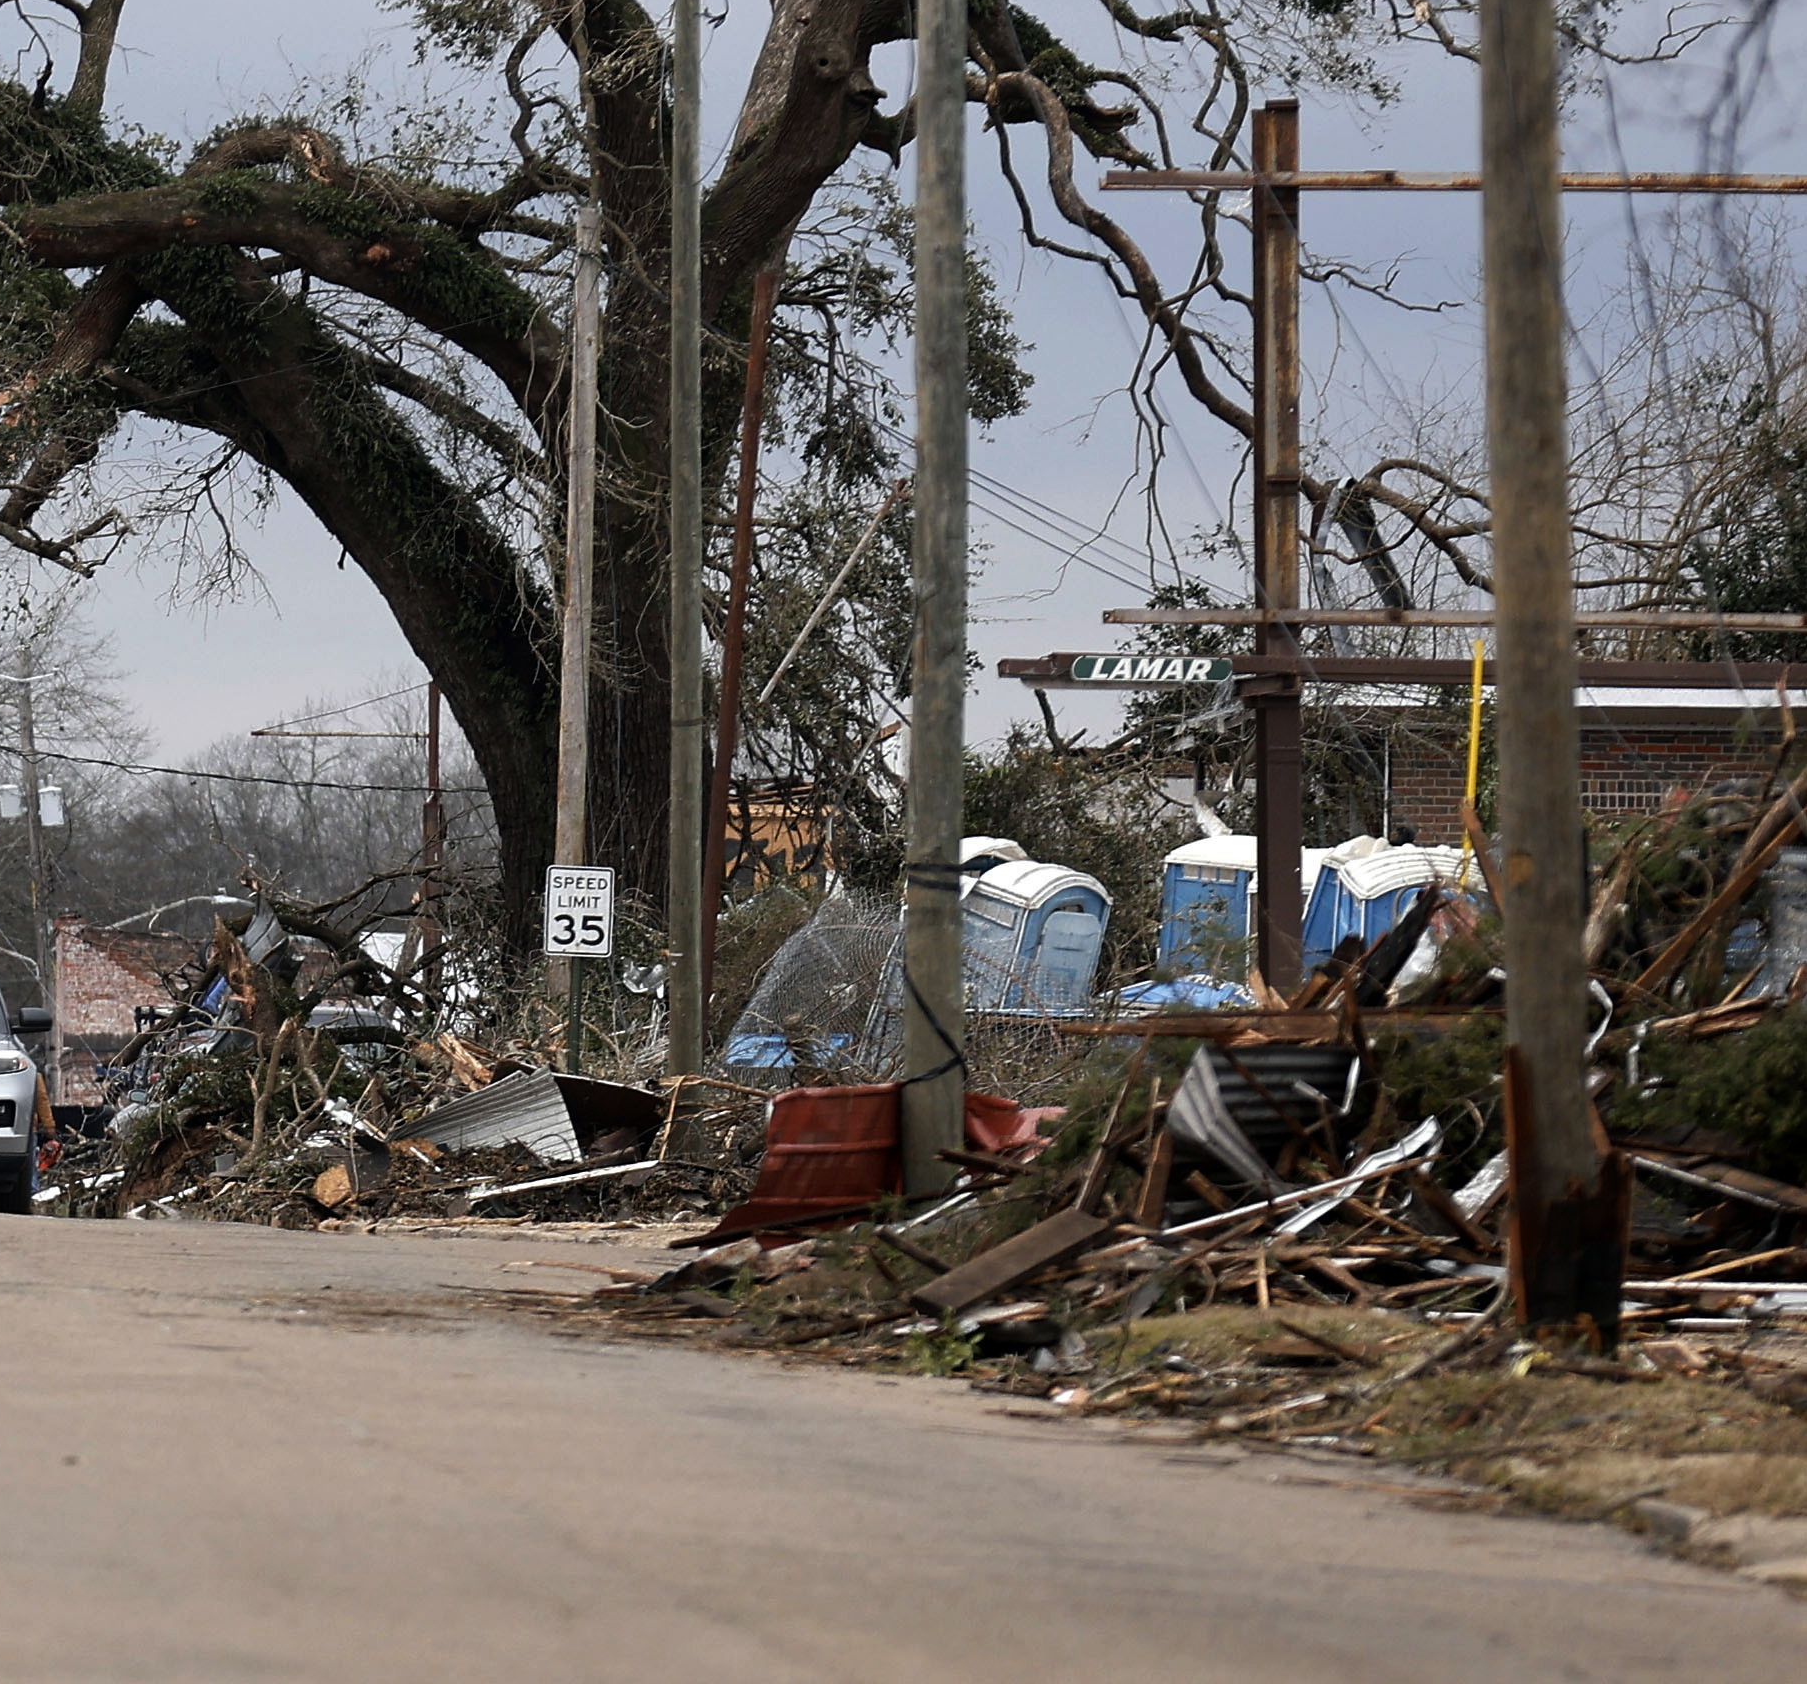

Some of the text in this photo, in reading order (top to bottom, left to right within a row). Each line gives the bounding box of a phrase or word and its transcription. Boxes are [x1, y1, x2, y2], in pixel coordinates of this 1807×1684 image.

[1090, 657, 1212, 681] LAMAR
[553, 876, 608, 890] SPEED
[557, 895, 602, 909] LIMIT
[552, 914, 605, 946] 35
